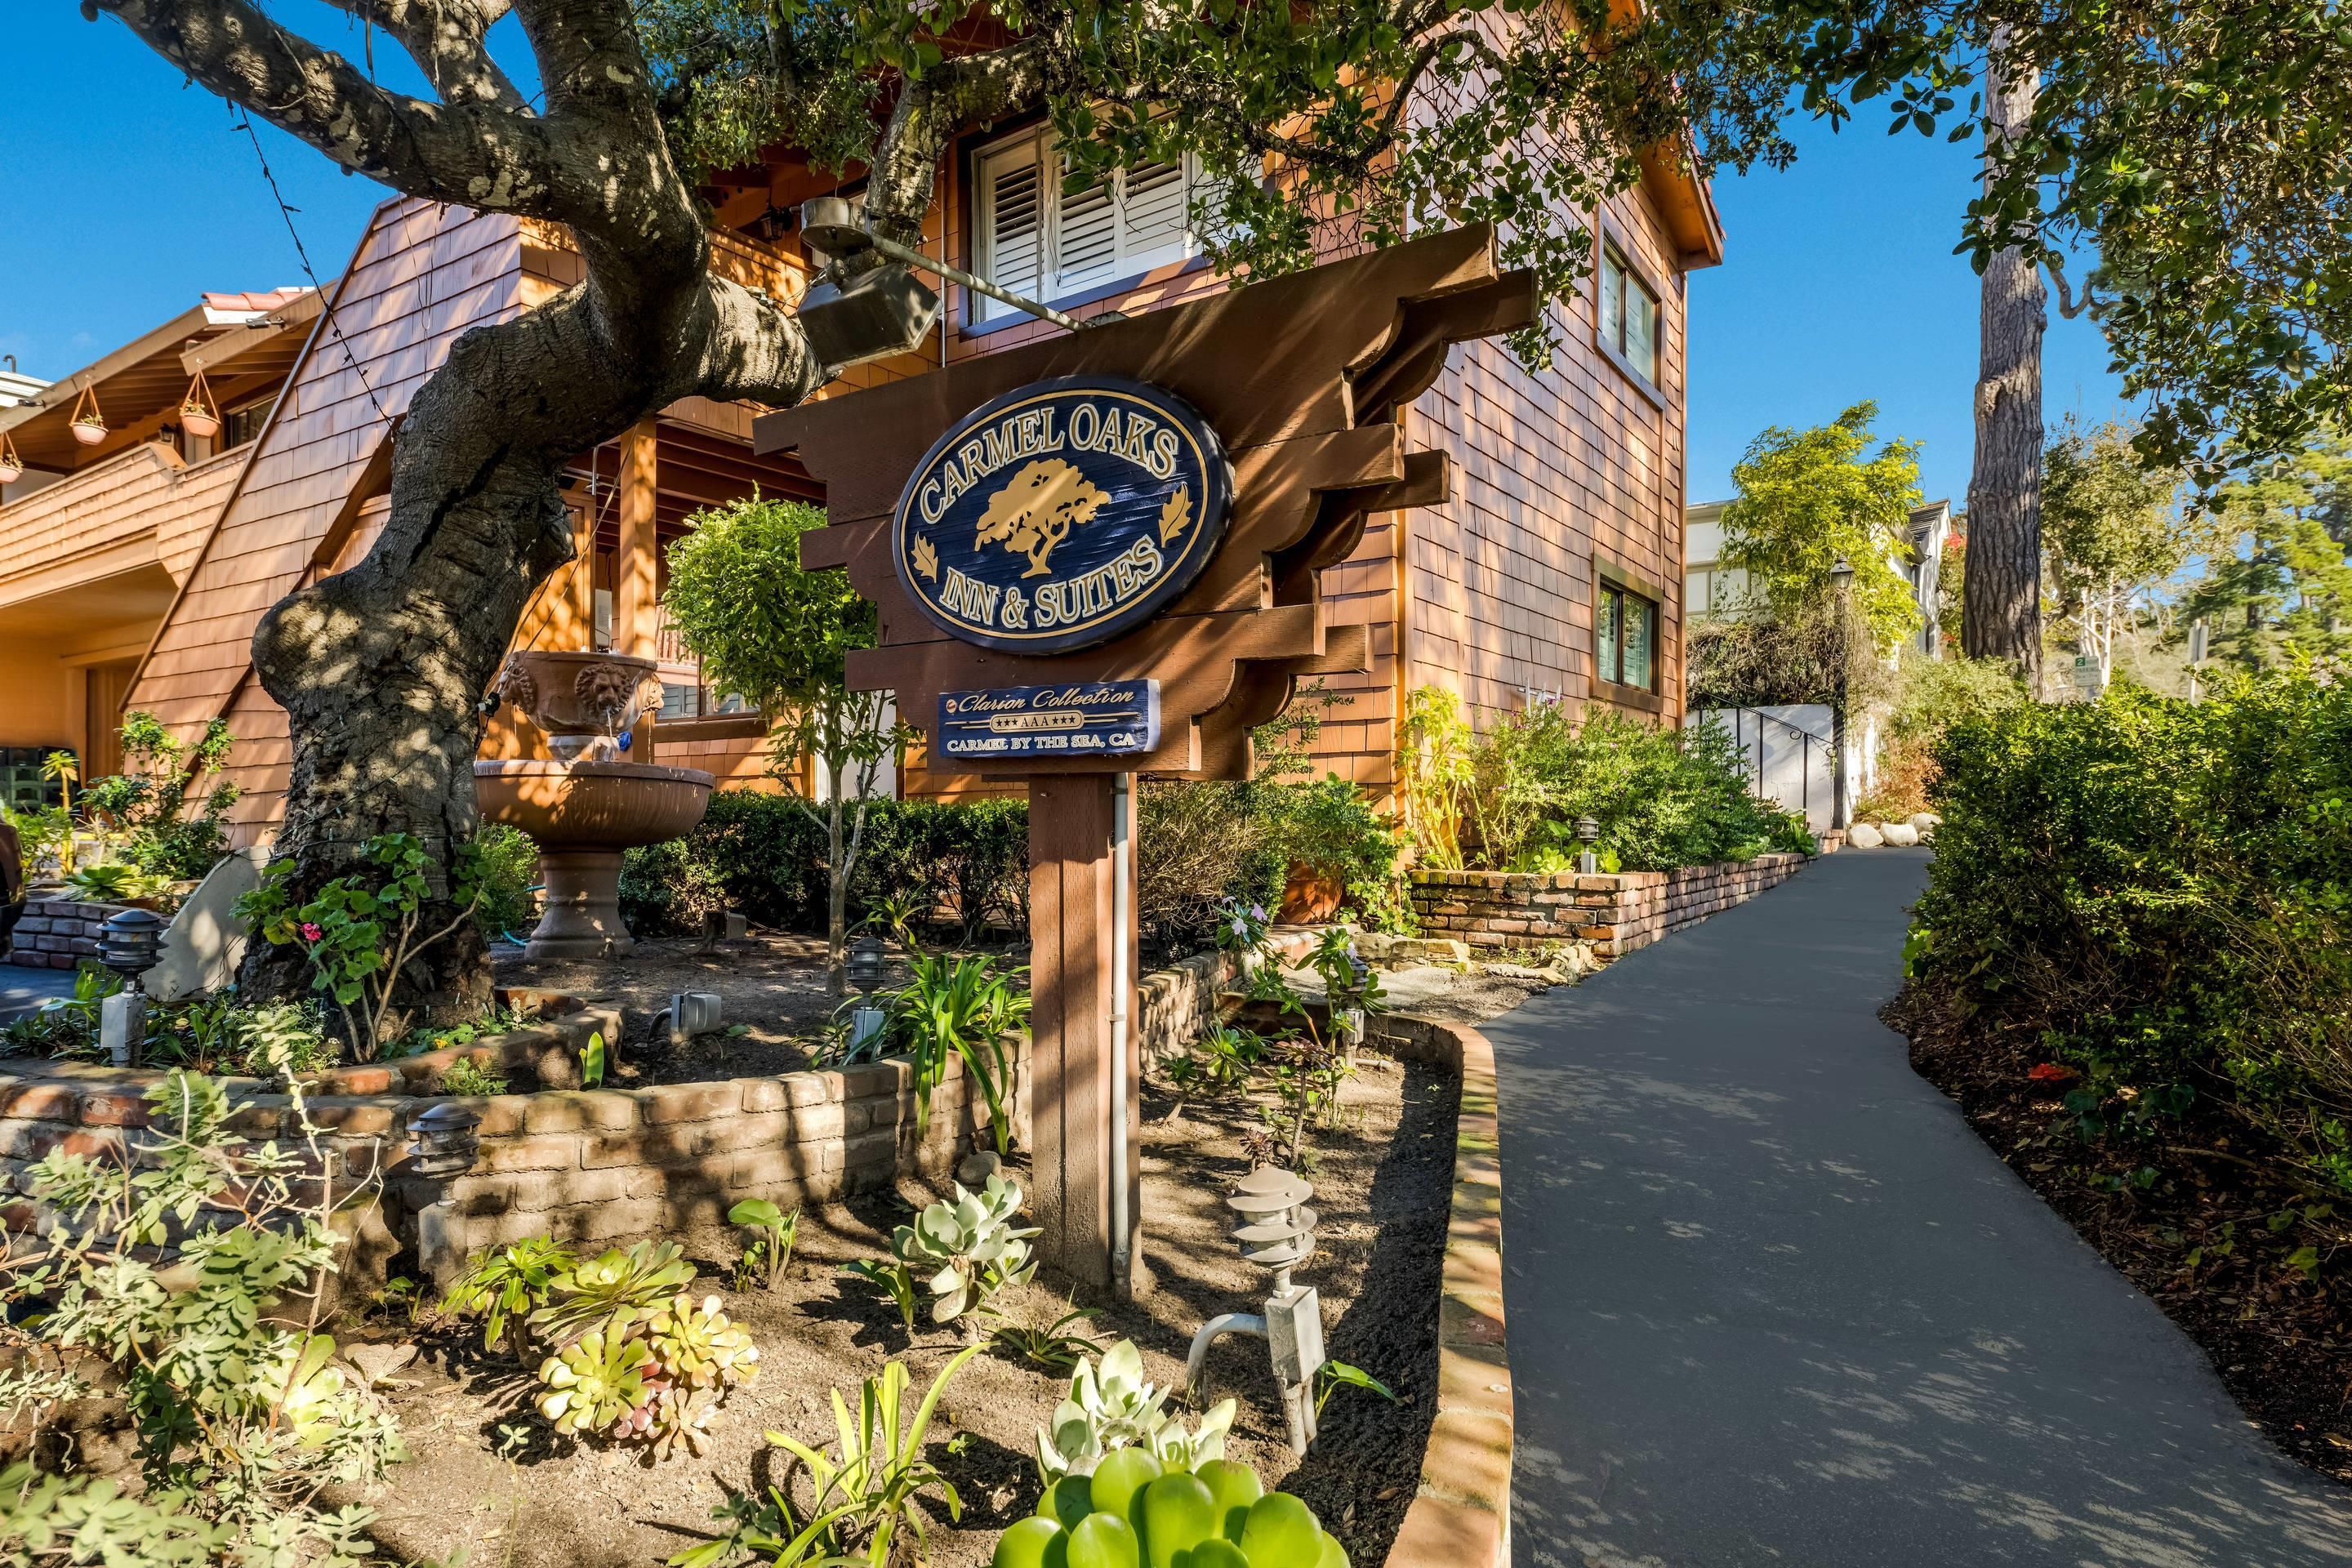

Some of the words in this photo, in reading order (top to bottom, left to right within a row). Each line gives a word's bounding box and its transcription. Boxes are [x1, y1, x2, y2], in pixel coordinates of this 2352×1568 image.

[920, 407, 1065, 524] CARMEL
[1069, 403, 1178, 479] OAKS
[939, 566, 1000, 626] INN
[1000, 586, 1029, 629] &
[1034, 534, 1164, 628] SUITES
[958, 693, 1026, 712] Clarion
[1032, 688, 1134, 708] Collection
[1021, 715, 1049, 728] AAA
[947, 738, 1009, 752] CARMEL
[1010, 737, 1031, 750] BY
[1034, 736, 1068, 749] THE
[1071, 734, 1106, 748] SEA,
[1108, 733, 1136, 746] CA
